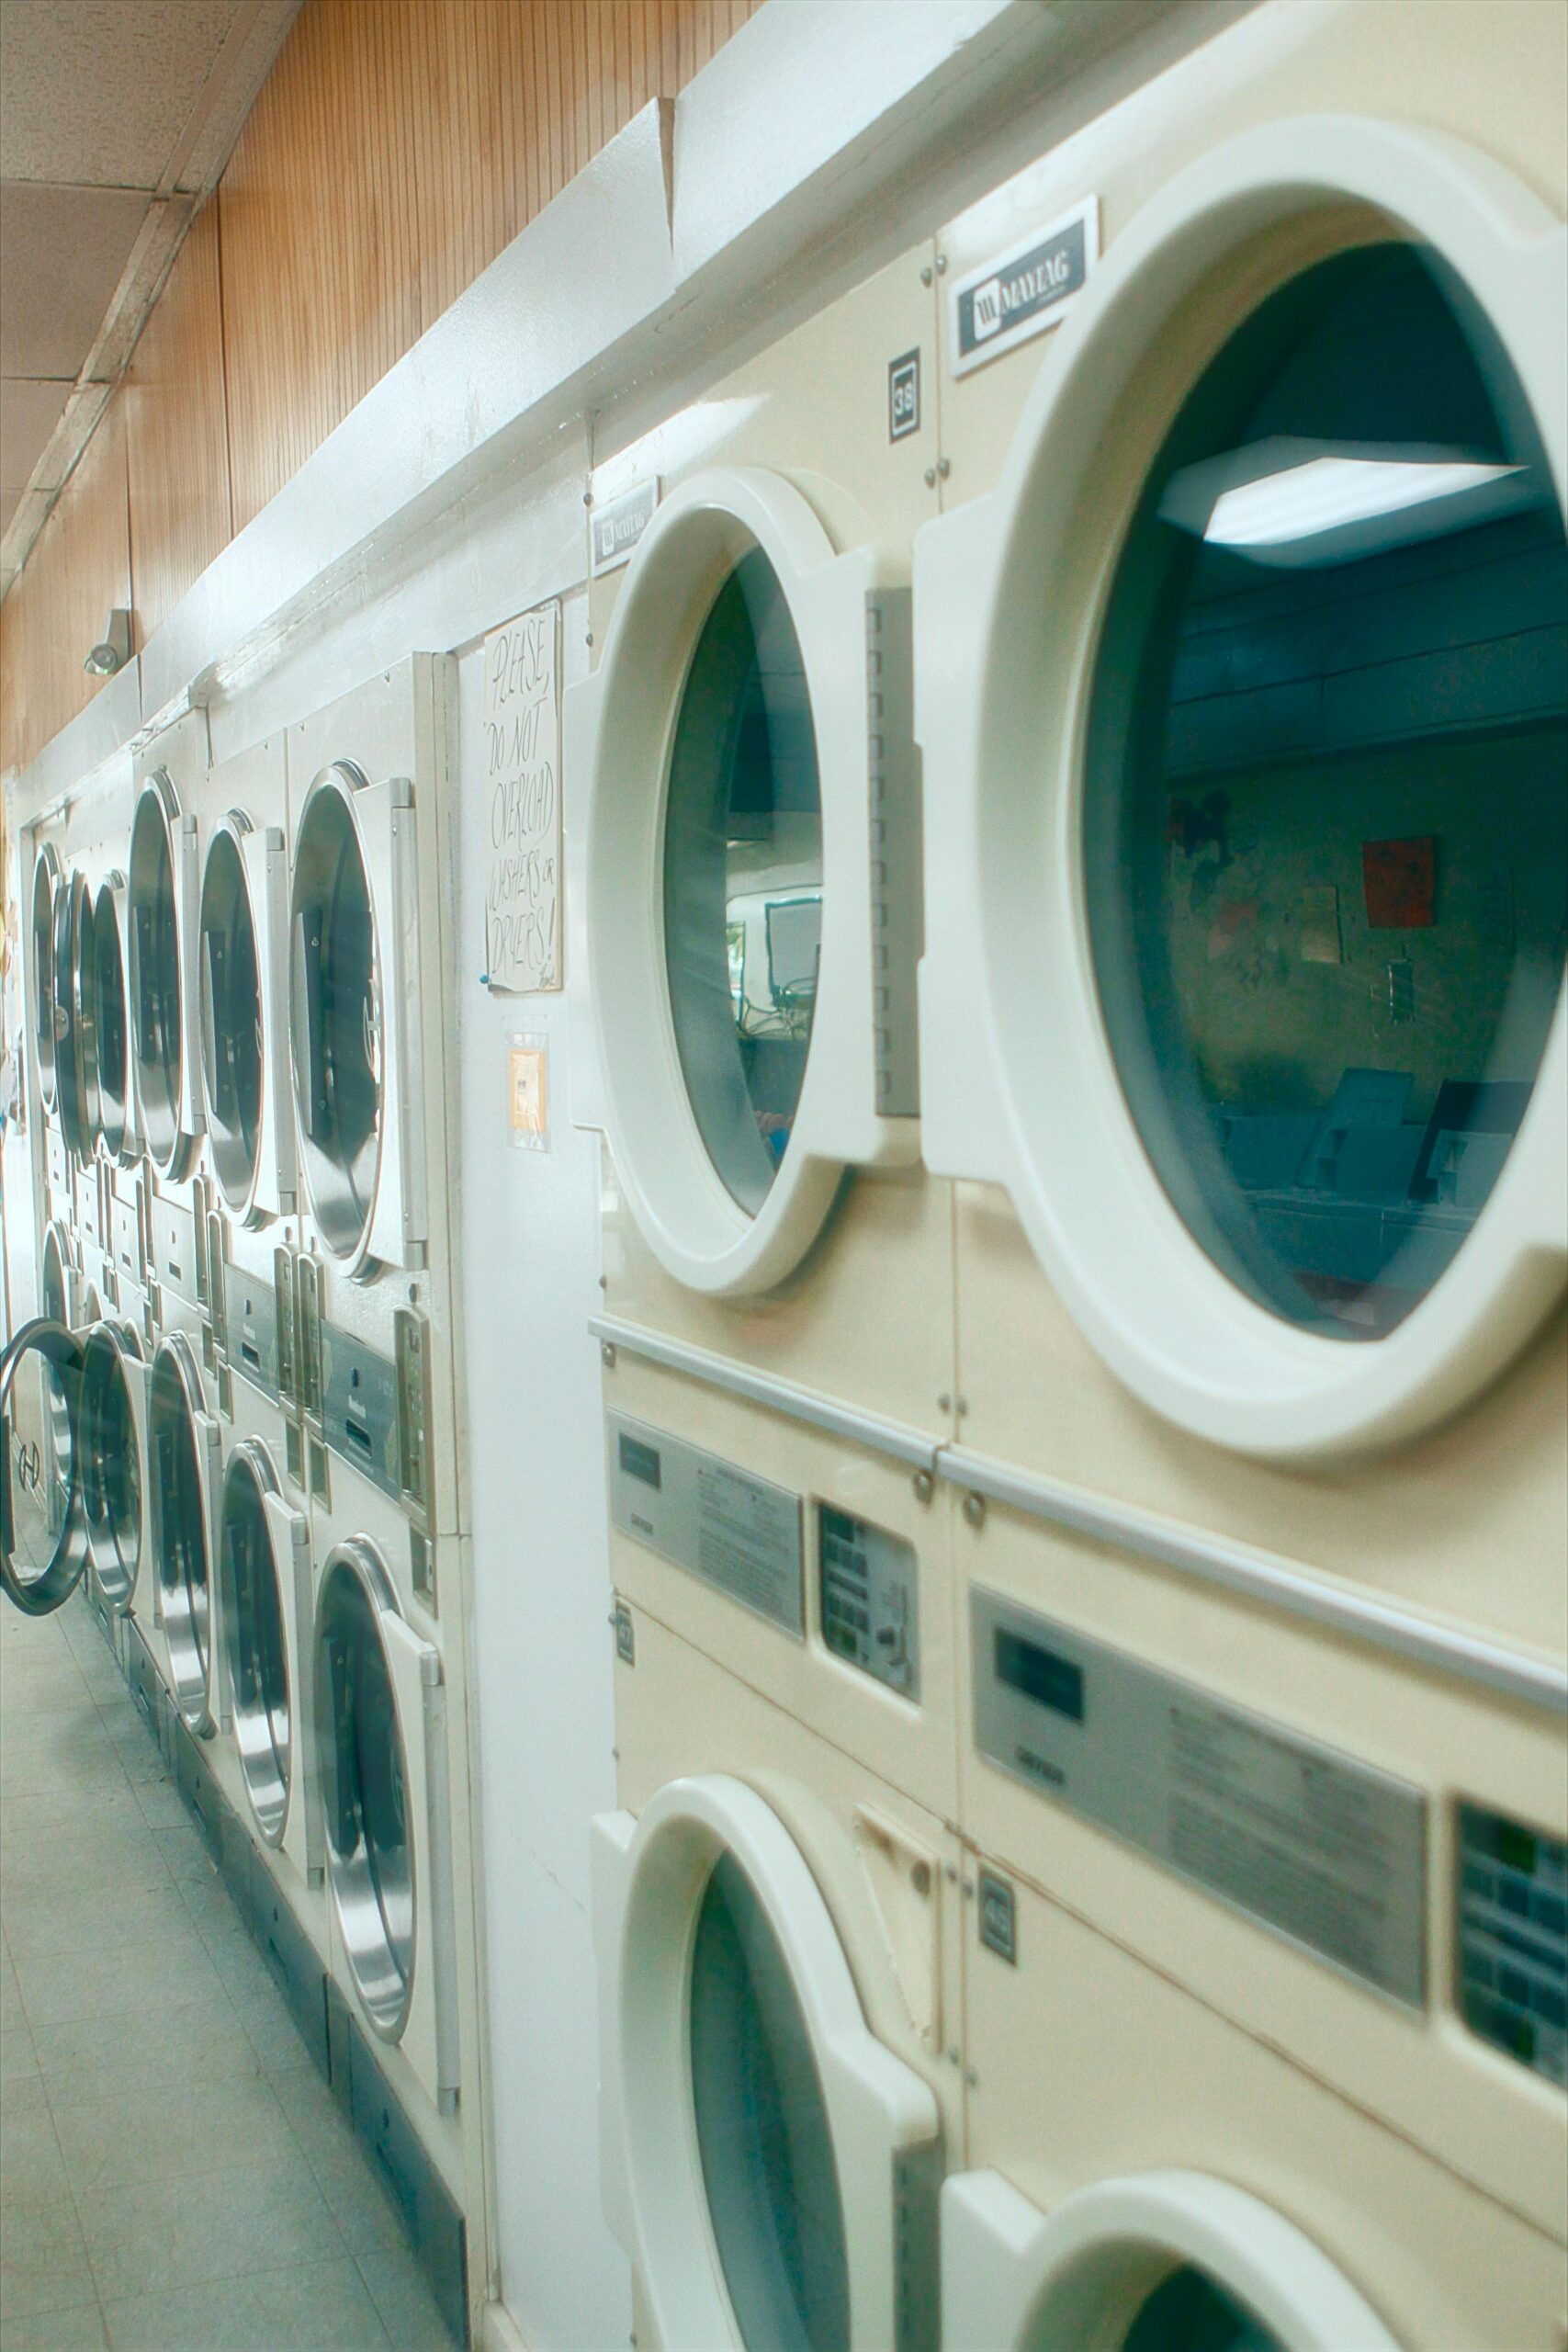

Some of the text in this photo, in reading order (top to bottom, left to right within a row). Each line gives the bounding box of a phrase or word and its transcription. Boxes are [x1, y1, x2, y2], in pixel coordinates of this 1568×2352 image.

[492, 618, 550, 710] PLEASE,
[487, 696, 548, 776] DO NOT
[491, 761, 554, 852] OVERLOAD
[489, 848, 540, 911] WASHERS
